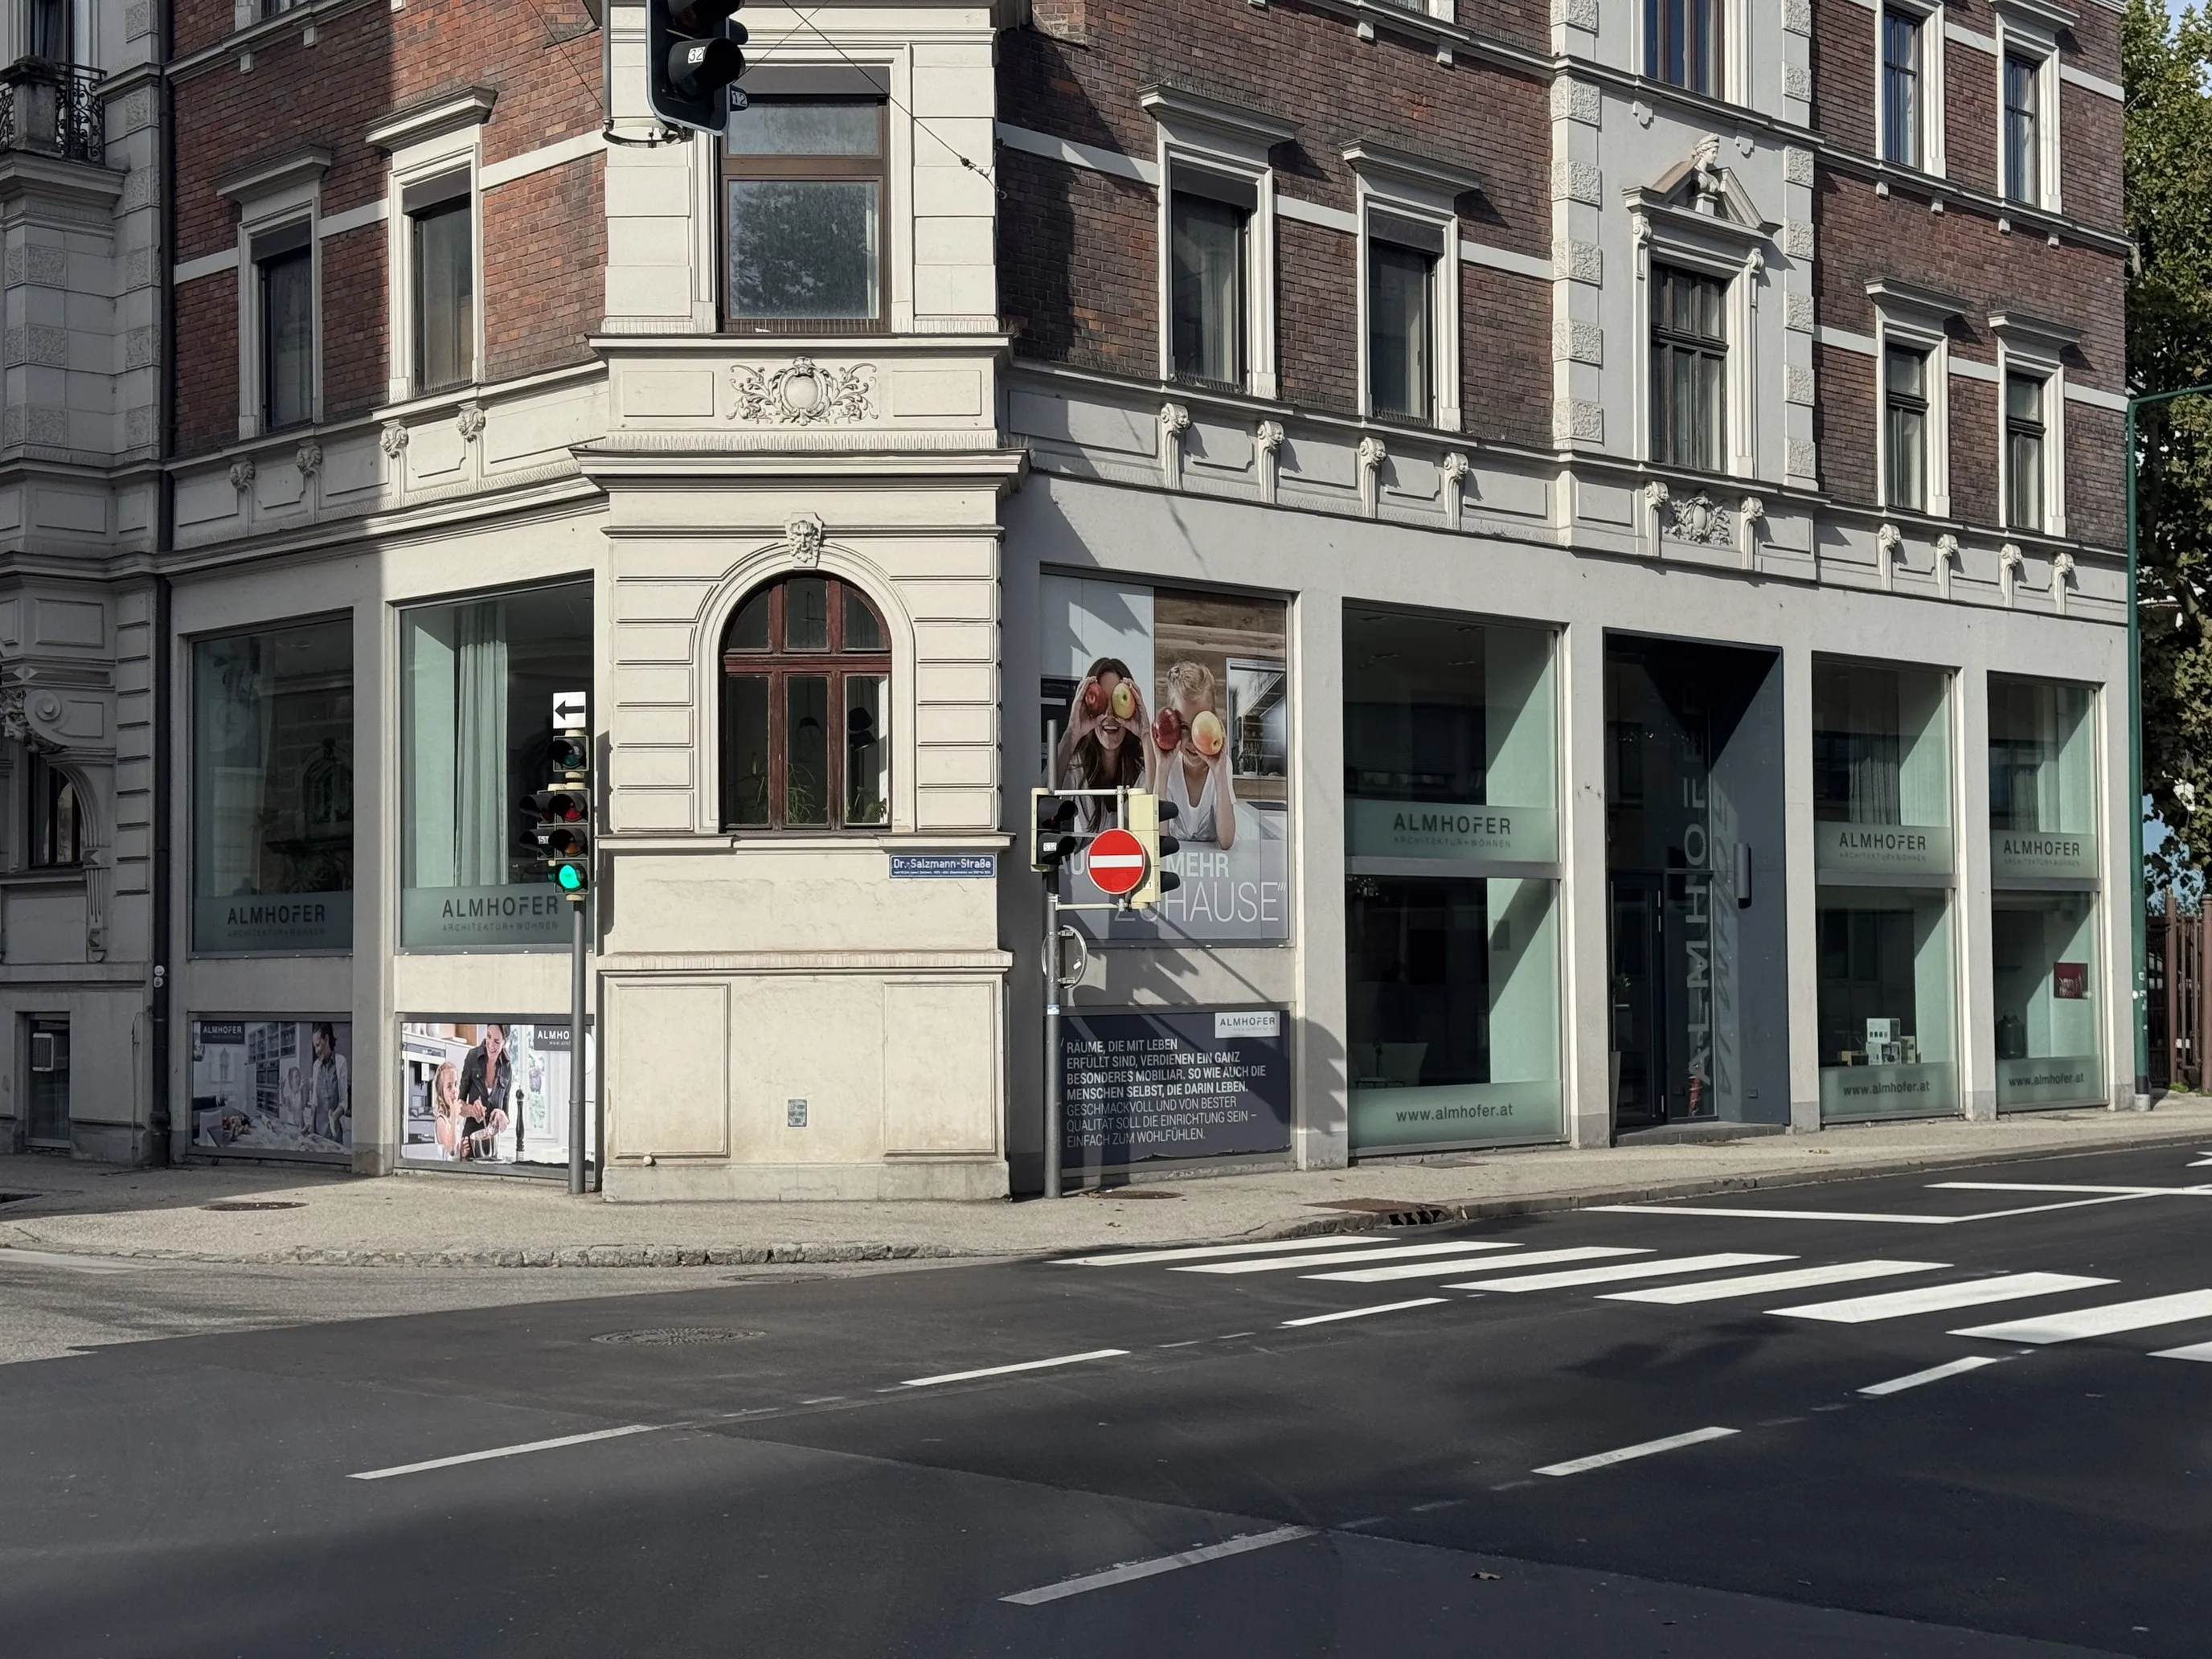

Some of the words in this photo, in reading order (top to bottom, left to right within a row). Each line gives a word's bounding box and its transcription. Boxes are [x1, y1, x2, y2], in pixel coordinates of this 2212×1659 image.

[688, 48, 703, 62] 32
[732, 92, 747, 106] 12
[1393, 813, 1511, 835] ALMHOFER
[1839, 832, 1926, 850] ALMHOFER
[2004, 839, 2080, 857] ALMHOFER
[893, 858, 992, 870] Dr.-Salzmann-Straße
[1165, 852, 1230, 878] MEHR
[227, 904, 325, 924] ALMHOFER
[442, 895, 559, 918] ALMHOFER
[203, 1025, 242, 1034] ALMHOFER
[1219, 1017, 1276, 1026] ALMHOFER
[537, 1030, 570, 1039] ALMHO
[1067, 1039, 1106, 1054] RÄUME,
[1108, 1040, 1124, 1052] DIE
[1127, 1039, 1145, 1051] MIT
[1147, 1038, 1178, 1051] LEBEN
[1067, 1055, 1109, 1069] ERFÜLLT
[1112, 1055, 1138, 1068] SIND,
[1141, 1053, 1194, 1067] VERDIENEN
[1197, 1052, 1213, 1064] EIN
[1215, 1051, 1240, 1063] GANZ
[1067, 1071, 1133, 1085] BESONDERES
[1136, 1069, 1186, 1082] MOBILIAR.
[1188, 1067, 1201, 1079] SO
[1203, 1067, 1221, 1079] WIE
[1223, 1066, 1249, 1077] AUCH
[1251, 1065, 1266, 1076] DIE
[2008, 1073, 2085, 1087] www.almhofer.at
[1067, 1087, 1124, 1100] MENSCHEN
[1126, 1084, 1165, 1098] SELBST,
[1166, 1083, 1182, 1096] DIE
[1185, 1082, 1214, 1095] DARIN
[1216, 1080, 1248, 1093] LEBEN.
[1843, 1080, 1930, 1096] www.almhofer.at
[1067, 1100, 1154, 1116] GESCHMACKVOLL
[1156, 1099, 1177, 1112] UND
[1179, 1098, 1199, 1110] VON
[1201, 1096, 1237, 1109] BESTER
[1396, 1103, 1514, 1123] www.almhofer.at
[1067, 1116, 1114, 1133] QUALITÄT
[1116, 1116, 1141, 1129] SOLL
[1143, 1115, 1158, 1128] DIE
[1161, 1111, 1225, 1127] EINRICHTUNG
[1227, 1110, 1248, 1123] SEIN
[1067, 1133, 1110, 1148] EINFACH
[1112, 1132, 1135, 1145] ZUM
[1137, 1127, 1206, 1142] WOHLFÜHLEN.
